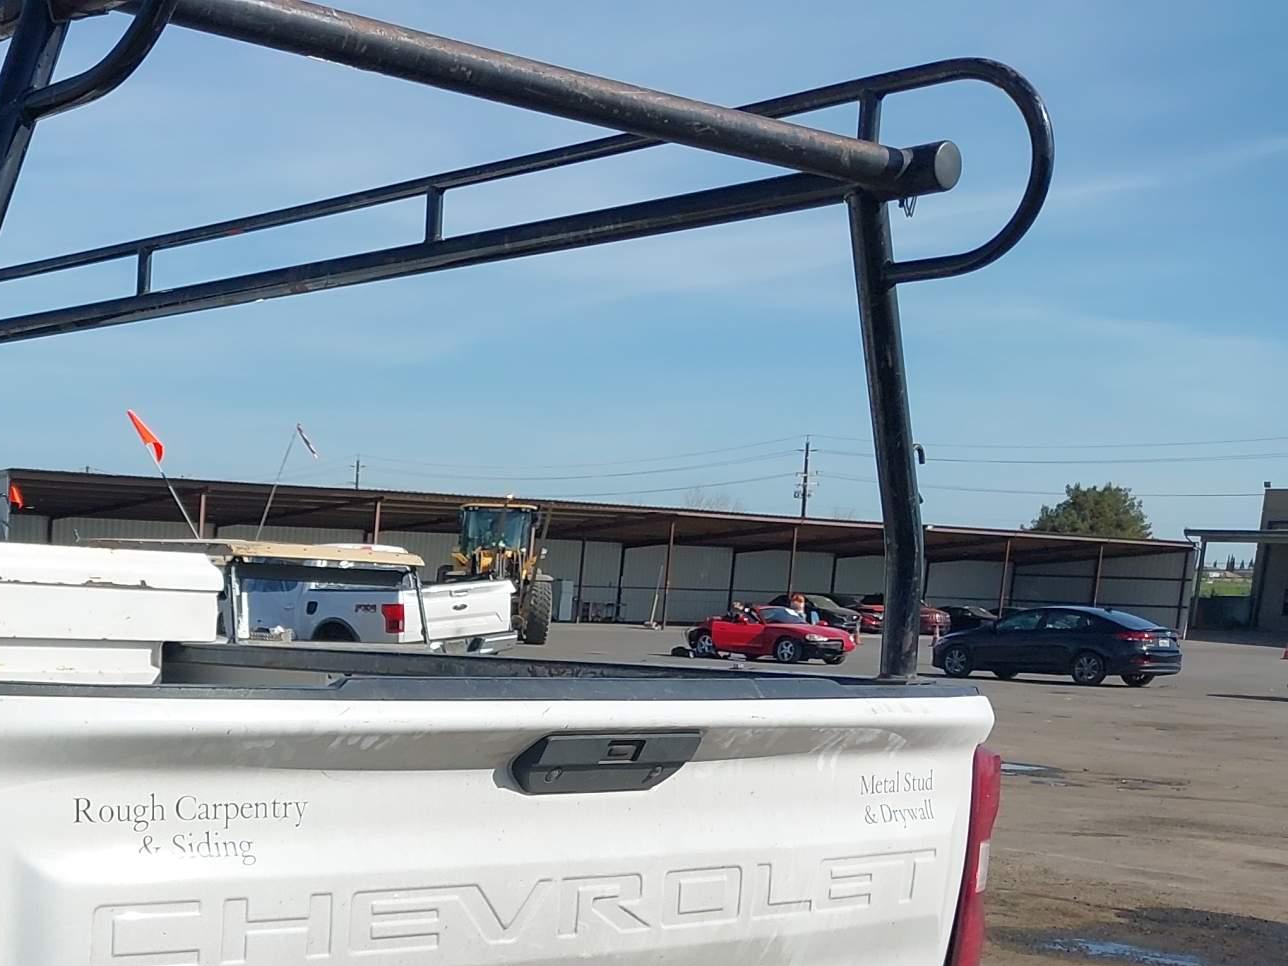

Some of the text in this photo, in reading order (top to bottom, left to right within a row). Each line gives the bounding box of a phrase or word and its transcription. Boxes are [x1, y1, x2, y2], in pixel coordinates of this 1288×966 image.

[860, 769, 934, 796] Metal Stud
[73, 793, 309, 833] Rough Carpentry
[864, 799, 935, 829] & Drywall
[138, 831, 257, 866] & Siding
